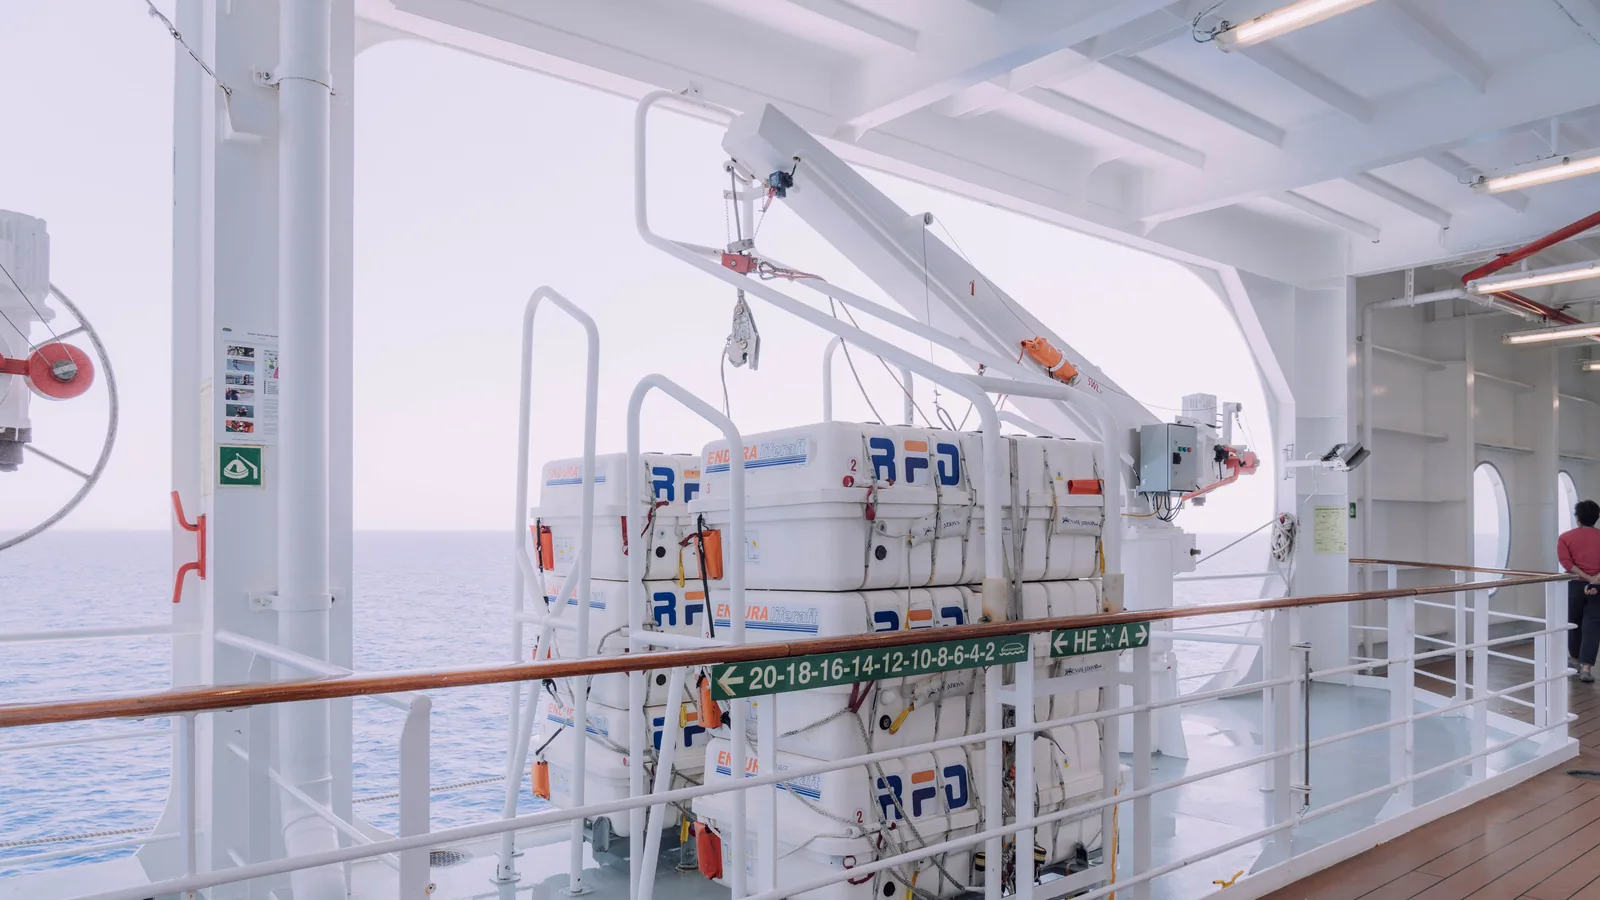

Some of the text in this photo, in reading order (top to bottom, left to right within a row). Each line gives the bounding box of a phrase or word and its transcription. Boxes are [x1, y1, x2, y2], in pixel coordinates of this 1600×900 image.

[707, 438, 807, 465] ENDRA liferaft
[869, 436, 960, 486] RFD
[850, 458, 858, 473] 2
[652, 466, 701, 504] RF
[705, 482, 712, 494] 3
[653, 591, 705, 627] RF
[715, 602, 819, 625] ENURA liferaft
[1117, 626, 1130, 648] A
[749, 641, 996, 690] 20-18-16-14-12-10-8-6-4-2
[876, 764, 969, 820] RFD
[856, 810, 864, 824] 2
